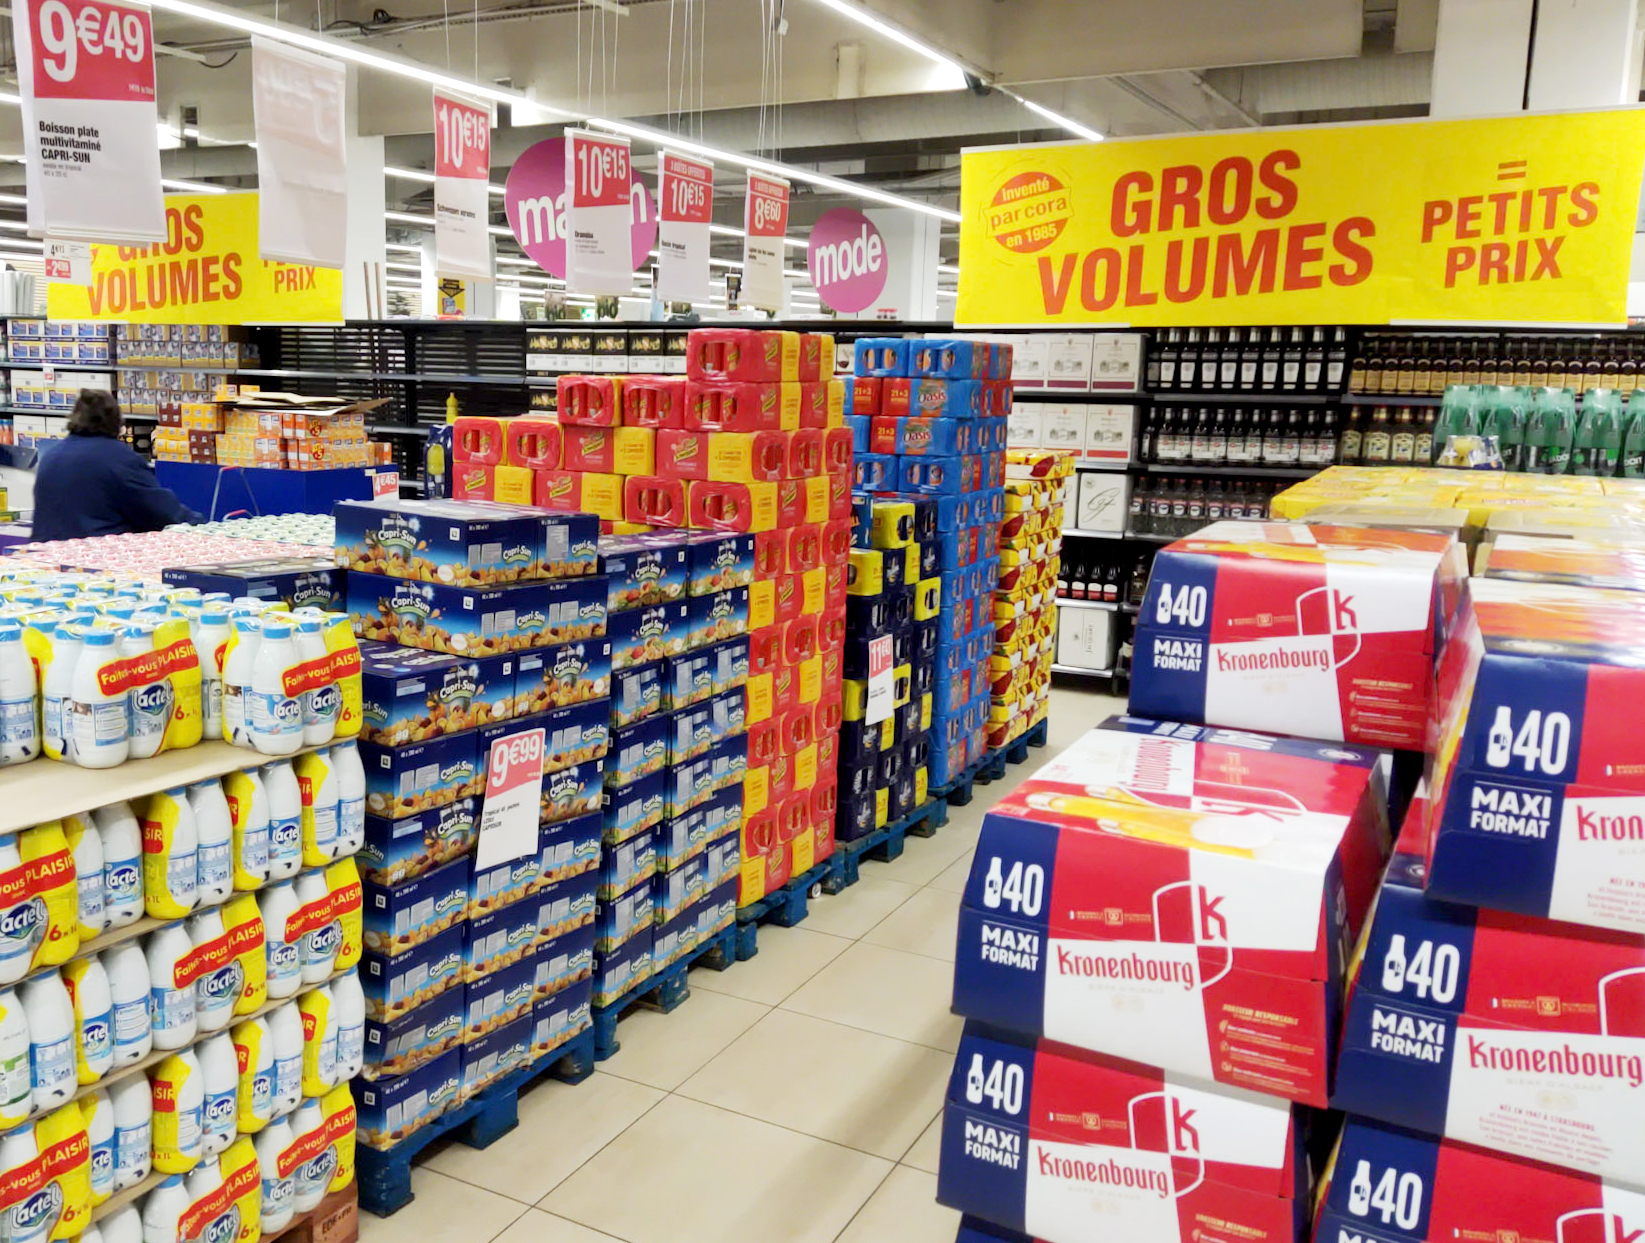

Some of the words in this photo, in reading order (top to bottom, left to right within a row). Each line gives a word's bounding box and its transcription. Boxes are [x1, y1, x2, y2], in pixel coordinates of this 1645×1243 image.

[40, 0, 144, 82] 9€49
[39, 121, 75, 135] Boisson
[78, 126, 100, 138] plate
[440, 104, 486, 168] 10€15
[40, 136, 101, 152] multivitaminé
[41, 149, 91, 164] CAPRI-SUN
[578, 144, 626, 198] 10€15
[672, 178, 705, 216] 10€15
[1110, 148, 1302, 239] GROS
[518, 182, 647, 246] man
[755, 198, 781, 230] 8€60
[991, 208, 1021, 231] par
[1024, 197, 1067, 218] cora
[1420, 181, 1600, 244] PETITS
[1006, 234, 1022, 248] en
[1025, 223, 1057, 242] 1985
[815, 222, 882, 288] mode
[1037, 216, 1376, 316] VOLUMES
[1444, 236, 1567, 290] PRIX
[88, 252, 242, 316] VOLUMES
[274, 268, 316, 294] PRIX
[374, 474, 396, 493] 4€45
[378, 529, 416, 545] Capri-Sun
[572, 540, 596, 552] Capri-Sun
[503, 544, 531, 558] Capri-Sun
[294, 586, 330, 602] Capri-Sun
[392, 597, 430, 613] Capri-Sun
[1172, 584, 1207, 628] 40
[517, 613, 545, 626] Capri-Sun
[580, 602, 605, 615] Capri-Sun
[1154, 638, 1202, 659] MAXI
[1218, 647, 1329, 673] Kronenbourg
[554, 658, 582, 674] Capri-Sun
[1154, 654, 1202, 672] FORMAT
[132, 679, 174, 712] lactel
[440, 680, 475, 698] Capri-Sun
[174, 705, 185, 720] 6
[342, 707, 352, 721] 6
[582, 724, 607, 738] Capri-Sun
[1512, 709, 1570, 776] 40
[441, 760, 473, 779] Capri-Sun
[492, 734, 540, 787] 9€99
[550, 778, 578, 797] Capri-Sun
[1472, 787, 1552, 819] MAXI
[438, 813, 473, 834] Capri-Sun
[1470, 811, 1550, 839] FORMAT
[574, 839, 599, 855] Capri-Sun
[25, 854, 75, 883] PLAISIR
[106, 865, 139, 890] lactel
[512, 861, 539, 880] Capri-Sun
[435, 889, 466, 911] Capri-Sun
[570, 893, 595, 911] Capri-Sun
[1002, 862, 1044, 917] 40
[49, 925, 62, 941] 6
[308, 922, 342, 954] lactel
[508, 924, 536, 942] Capri-Sun
[981, 924, 1038, 956] MAXI
[342, 942, 352, 956] 6
[568, 949, 592, 967] Capri-Sun
[981, 944, 1038, 972] FORMAT
[430, 953, 460, 977] Capri-Sun
[1057, 944, 1194, 991] Kronenbourg
[1406, 940, 1460, 1004] 40
[203, 961, 242, 998] lactel
[244, 982, 254, 998] 6
[505, 983, 532, 1003] Capri-Sun
[568, 1002, 590, 1021] Capri-Sun
[427, 1015, 461, 1037] Capri-Sun
[1373, 1010, 1446, 1046] MAXI
[498, 1043, 525, 1063] Capri-Sun
[1372, 1031, 1444, 1064] FORMAT
[1468, 1034, 1642, 1088] Kronenbourg
[429, 1078, 459, 1104] Capri-Sun
[984, 1059, 1024, 1115] 40
[206, 1099, 234, 1120] lactel
[965, 1120, 1020, 1153] MAXI
[965, 1140, 1020, 1170] FORMAT
[337, 1164, 345, 1178] 6
[1037, 1145, 1170, 1199] Kronenbourg
[11, 1184, 62, 1224] lactel
[1371, 1166, 1422, 1230] 40
[63, 1206, 75, 1222] 6
[207, 1208, 239, 1242] lactel
[240, 1224, 250, 1240] 6
